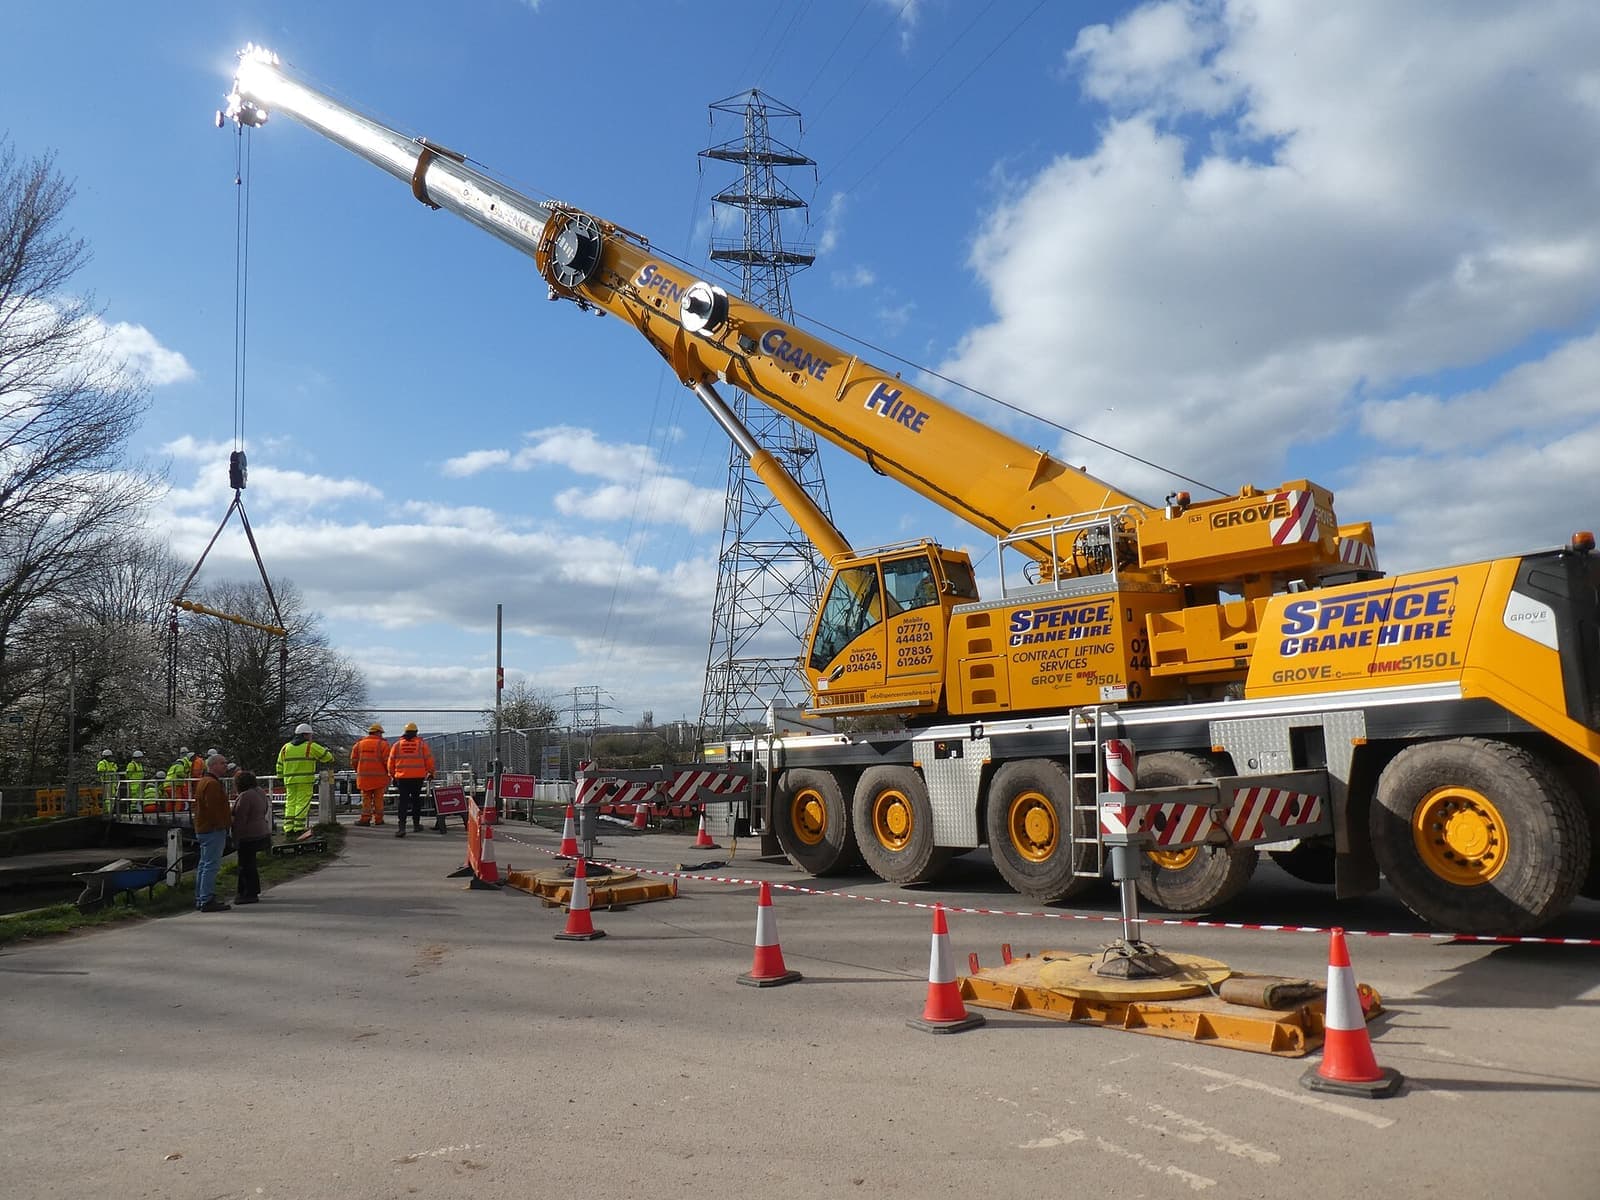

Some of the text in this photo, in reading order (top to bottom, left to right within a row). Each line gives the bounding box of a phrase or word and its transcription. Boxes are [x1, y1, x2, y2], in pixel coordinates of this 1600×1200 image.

[759, 328, 833, 382] CRANE
[863, 382, 930, 434] HIRE
[1213, 502, 1291, 530] GROVE
[1009, 605, 1110, 634] SPENCE
[1281, 588, 1450, 637] SPENCE
[1510, 610, 1548, 622] GROVE
[897, 622, 931, 635] 07770
[1009, 624, 1112, 648] CRANE HIRE
[895, 632, 934, 645] 444821
[1280, 619, 1454, 659] CRANE HIRE
[849, 651, 879, 664] 01626
[898, 645, 933, 657] 07836
[1012, 642, 1116, 664] CONTRACT LIFTING
[846, 661, 883, 674] 824645
[896, 655, 935, 668] 612667
[1039, 657, 1088, 673] SERVICES
[1031, 672, 1073, 686] GROVE
[1272, 665, 1332, 684] GROVE
